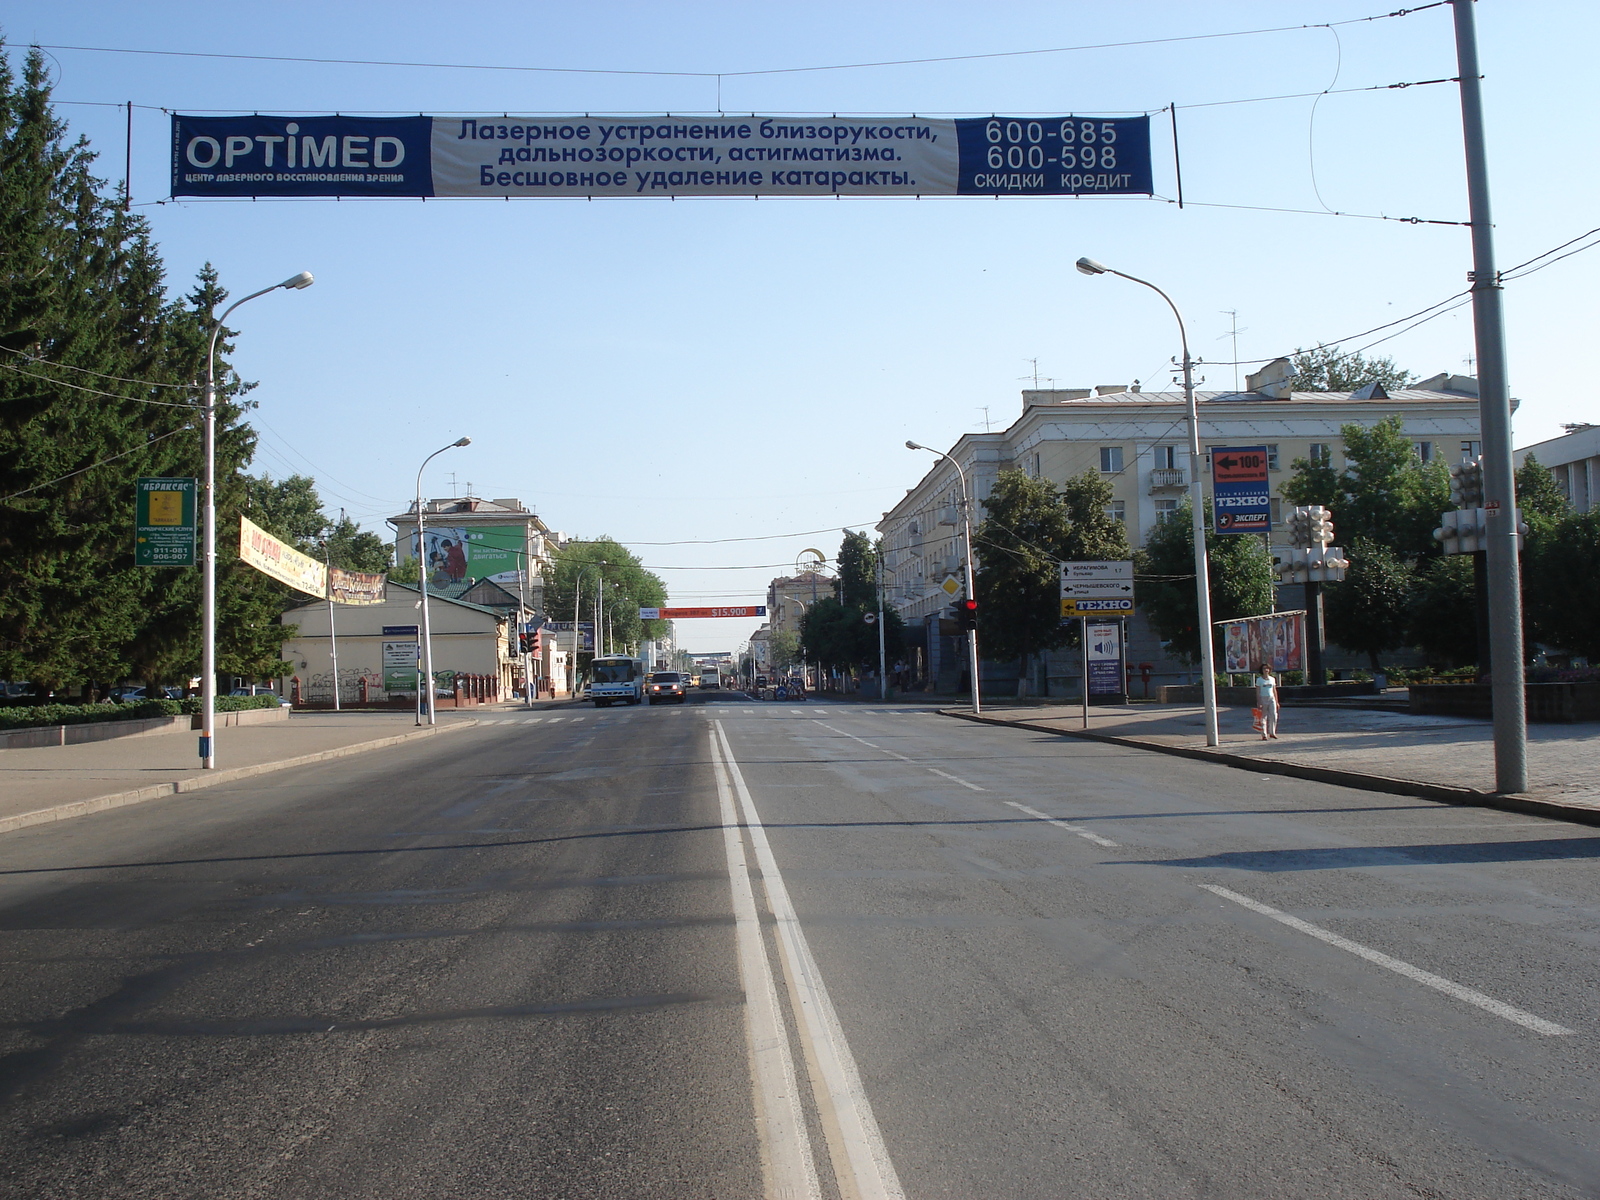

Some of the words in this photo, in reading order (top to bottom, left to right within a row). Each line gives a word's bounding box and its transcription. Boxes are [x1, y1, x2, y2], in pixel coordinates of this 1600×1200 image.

[458, 119, 591, 146] Лазерное
[598, 124, 751, 146] устранение
[759, 119, 938, 145] близорукости,
[985, 121, 1117, 144] 600-685
[498, 146, 722, 168] дальнозоркости,
[728, 146, 902, 161] астигматизма.
[987, 146, 1117, 169] 600-598
[185, 174, 214, 183] ЦЕНТР
[216, 173, 274, 182] ЛАЗЕРНОГО
[276, 173, 365, 182] ВОССТАНОВЛЕНИЯ
[366, 174, 404, 182] ЗРЕНИЯ
[480, 165, 628, 187] Бесшовное
[635, 171, 763, 192] удаление
[771, 170, 916, 192] катаракты.
[974, 174, 1044, 190] скидки
[1061, 174, 1131, 191] кредит
[1215, 496, 1269, 507] ТЕХНО
[1235, 513, 1268, 522] ЭКСПЕРТ
[711, 608, 747, 617] $15.900
[1076, 600, 1132, 610] ТЕХНО
